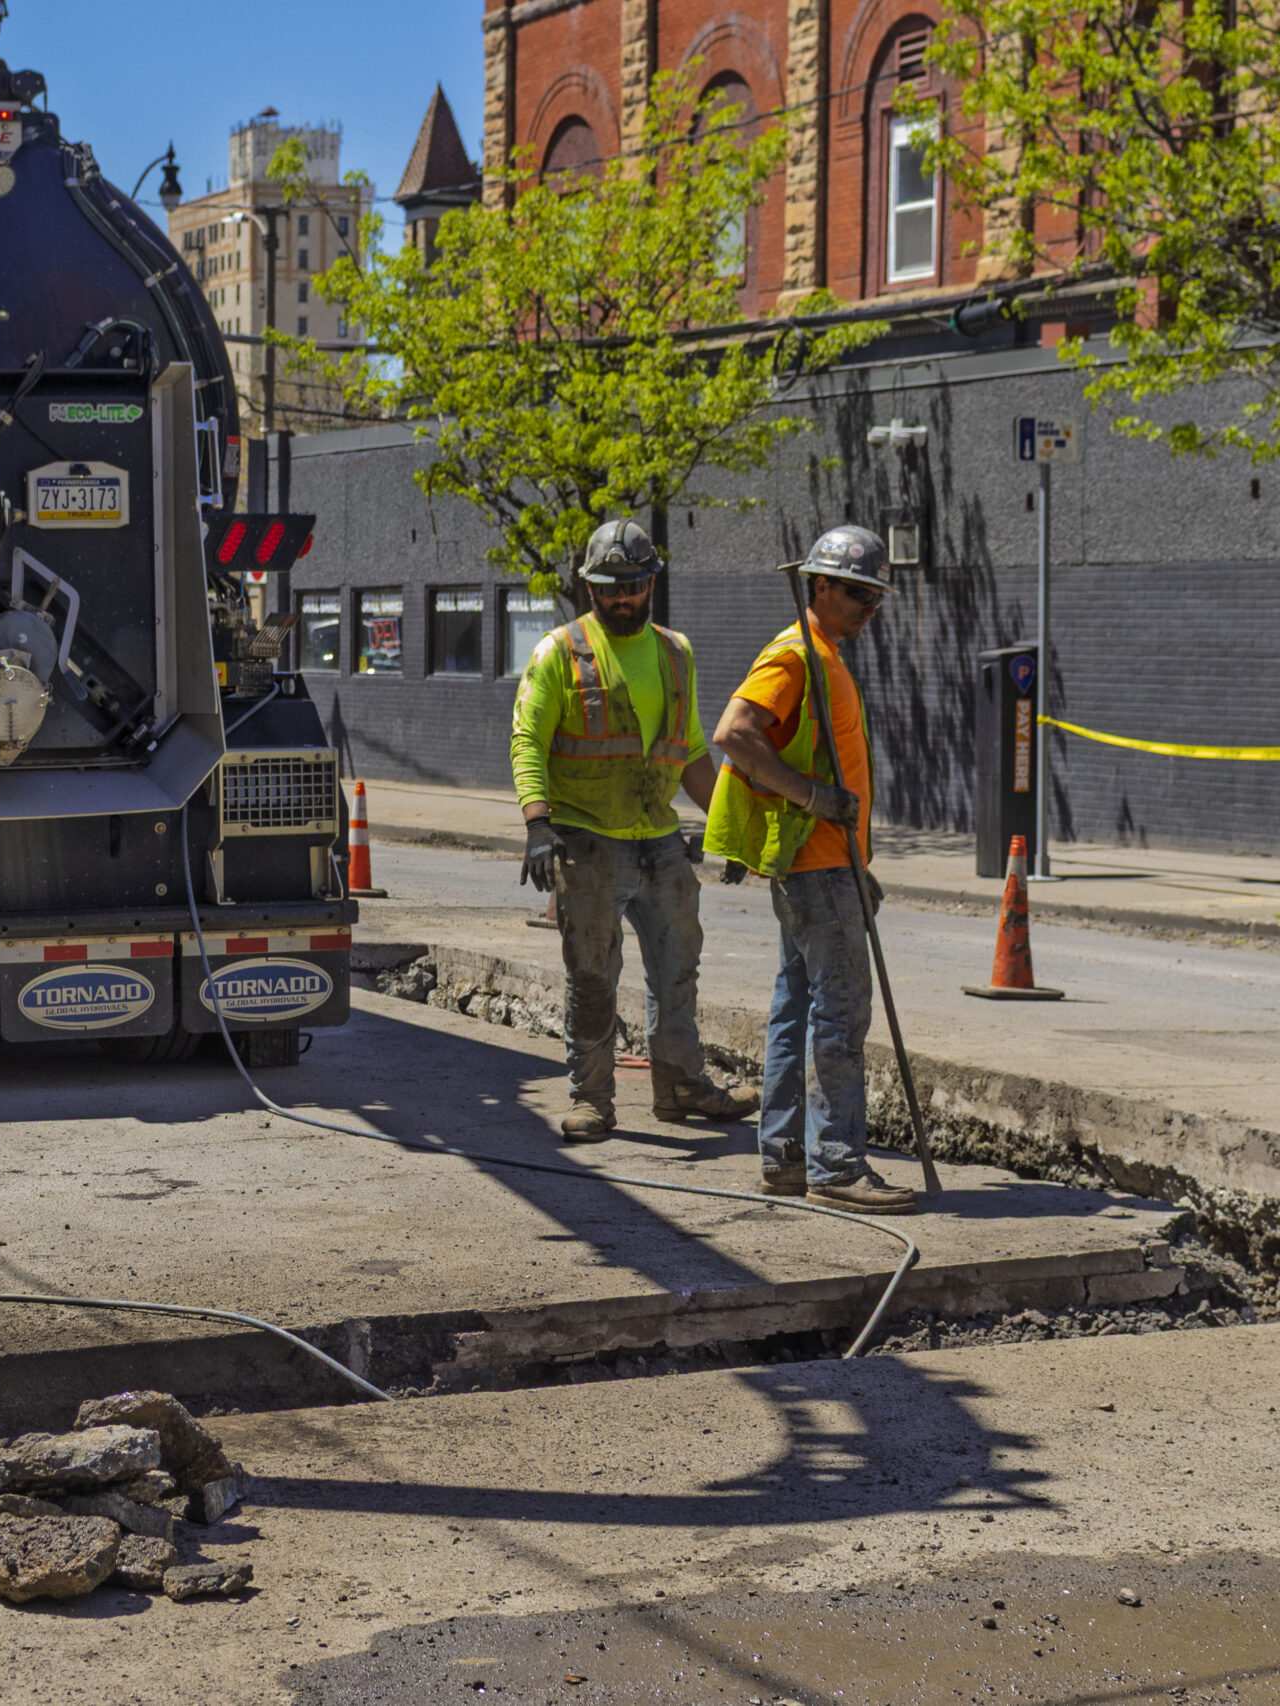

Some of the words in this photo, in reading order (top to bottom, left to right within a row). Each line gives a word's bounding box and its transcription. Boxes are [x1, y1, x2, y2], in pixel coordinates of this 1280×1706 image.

[67, 405, 125, 420] ECO-LITE
[1018, 665, 1030, 680] P
[1016, 701, 1030, 737] PAY
[1015, 741, 1029, 788] HERE
[32, 983, 142, 1006] TORNADO
[214, 976, 320, 998] TORNADO
[45, 1006, 78, 1016] GLOBAL
[80, 1004, 129, 1012] HYDROVACS
[226, 998, 259, 1007] GLOBAL
[261, 995, 307, 1004] HYDROVACS
